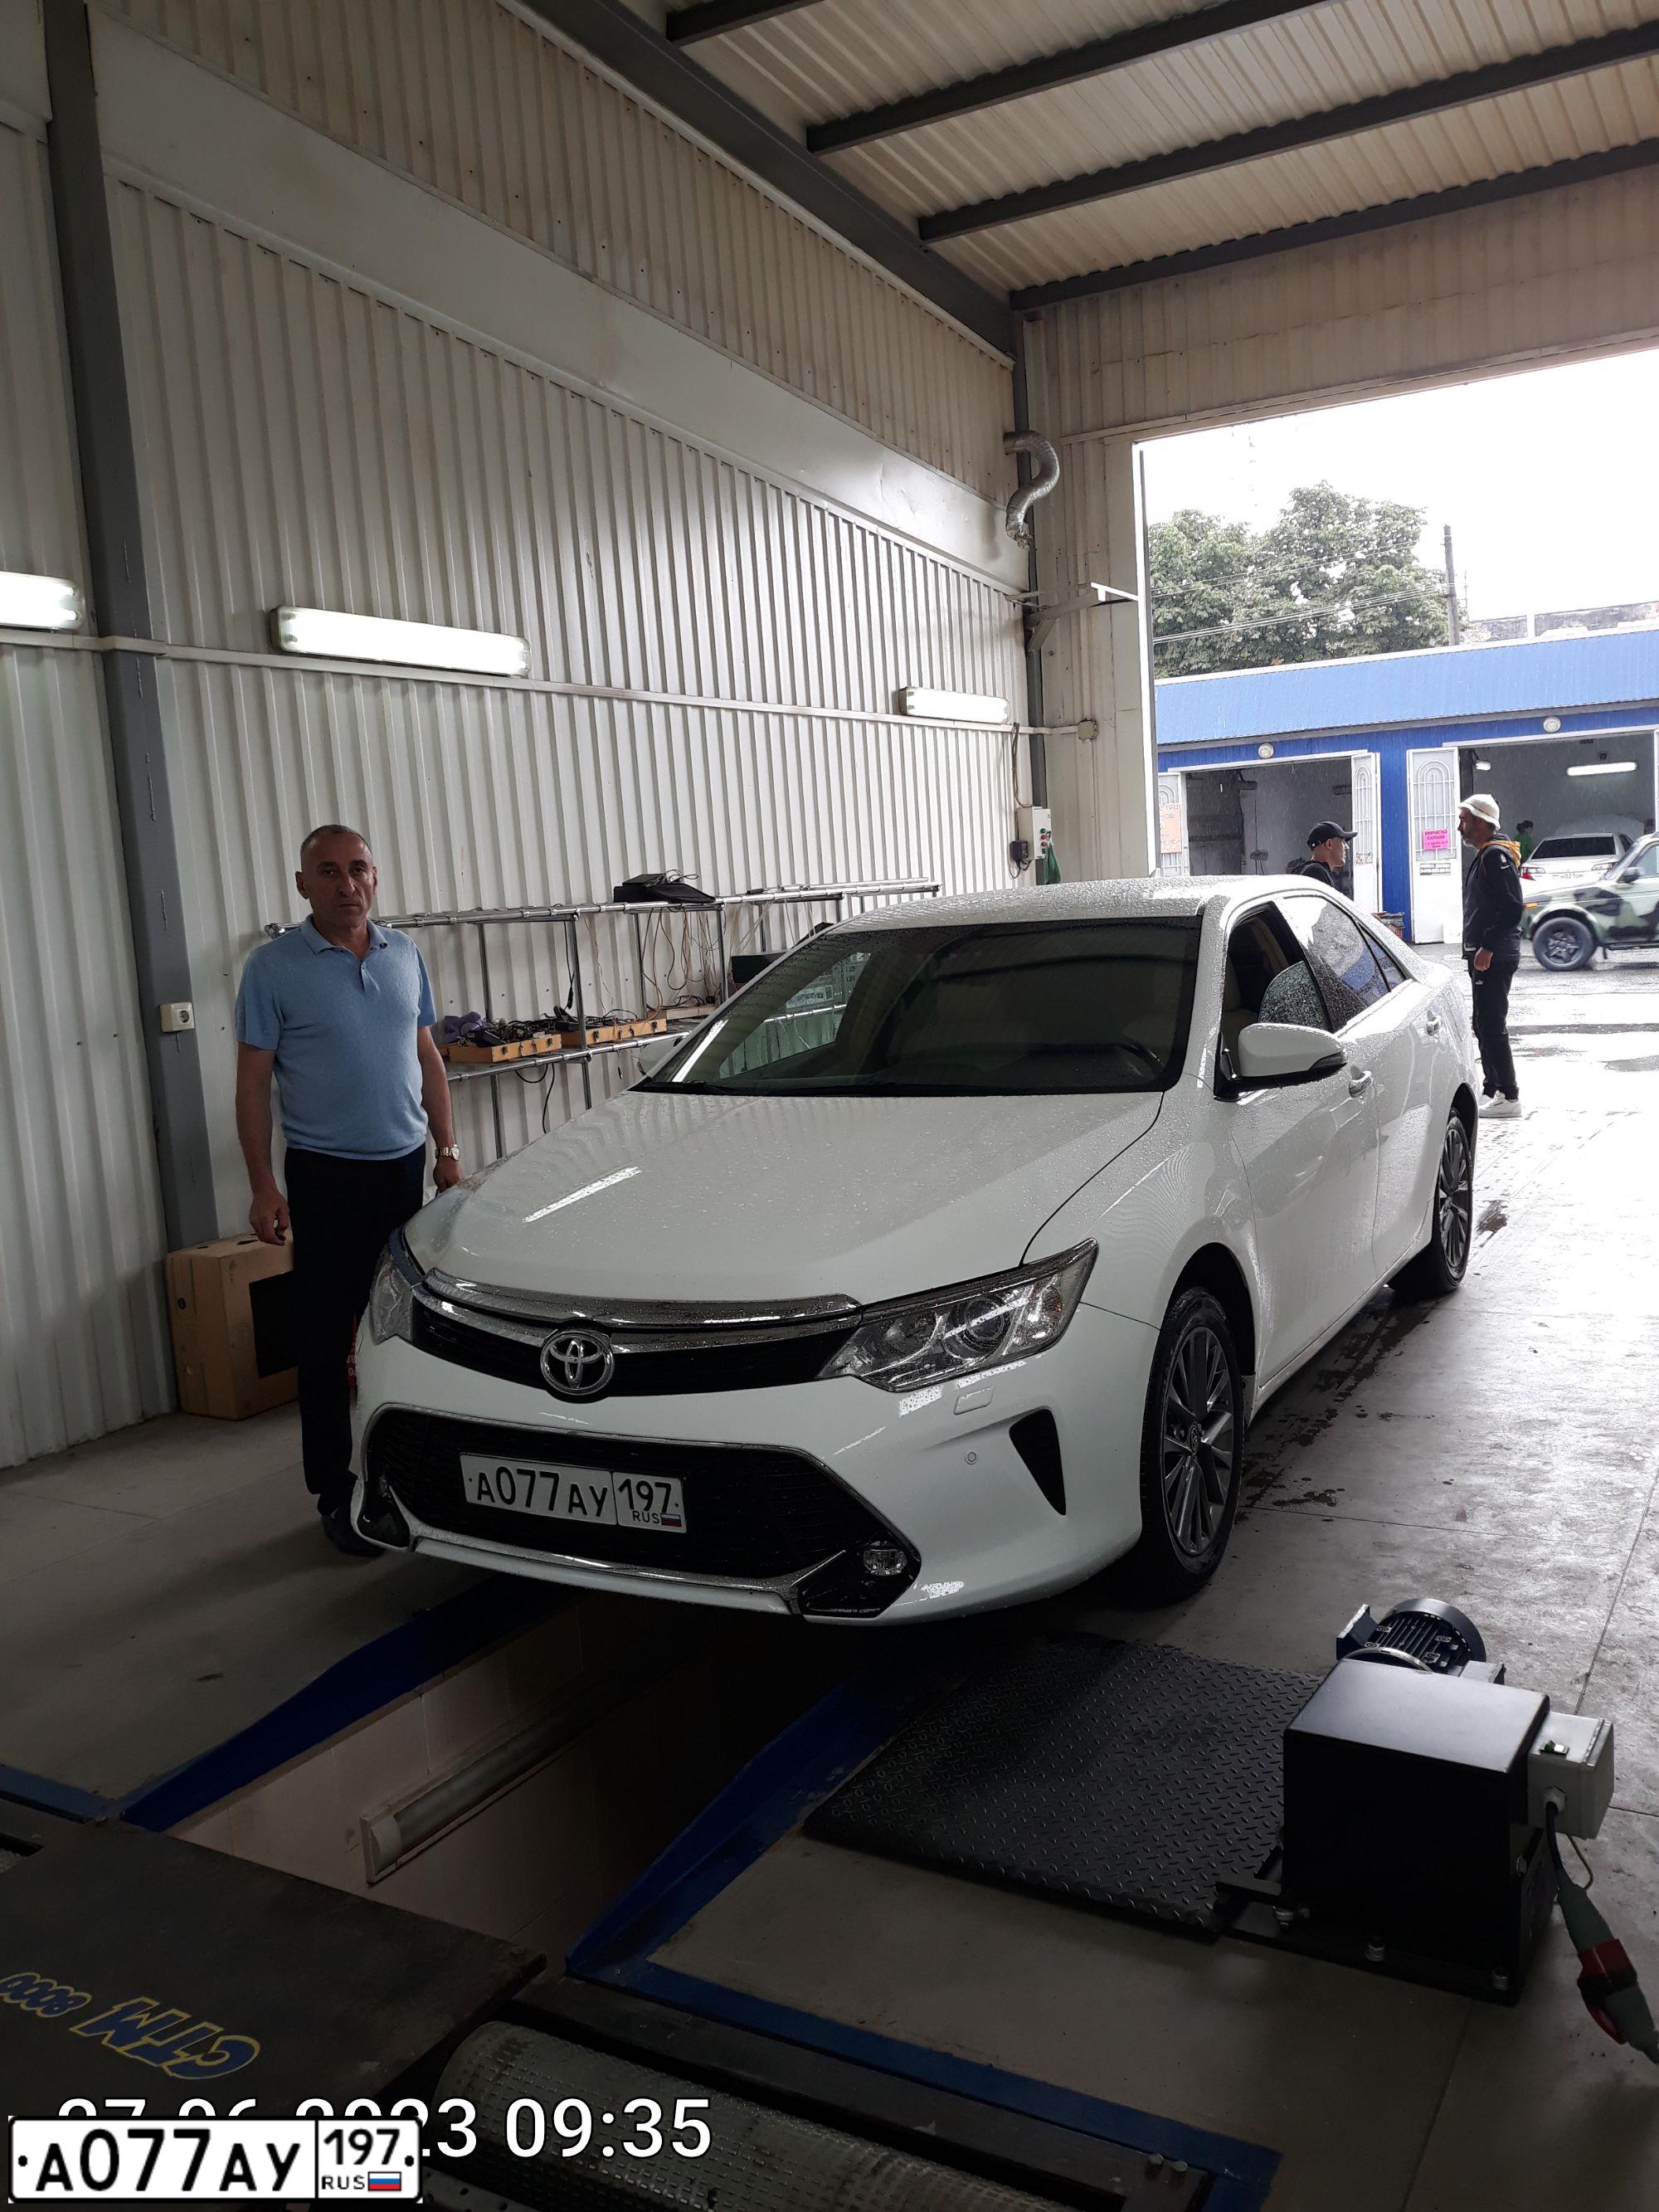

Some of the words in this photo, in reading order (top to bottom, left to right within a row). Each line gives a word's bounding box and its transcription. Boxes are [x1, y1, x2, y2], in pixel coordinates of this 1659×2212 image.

[477, 1466, 608, 1518] А077АУ
[618, 1479, 672, 1512] 197
[632, 1510, 660, 1524] RUS
